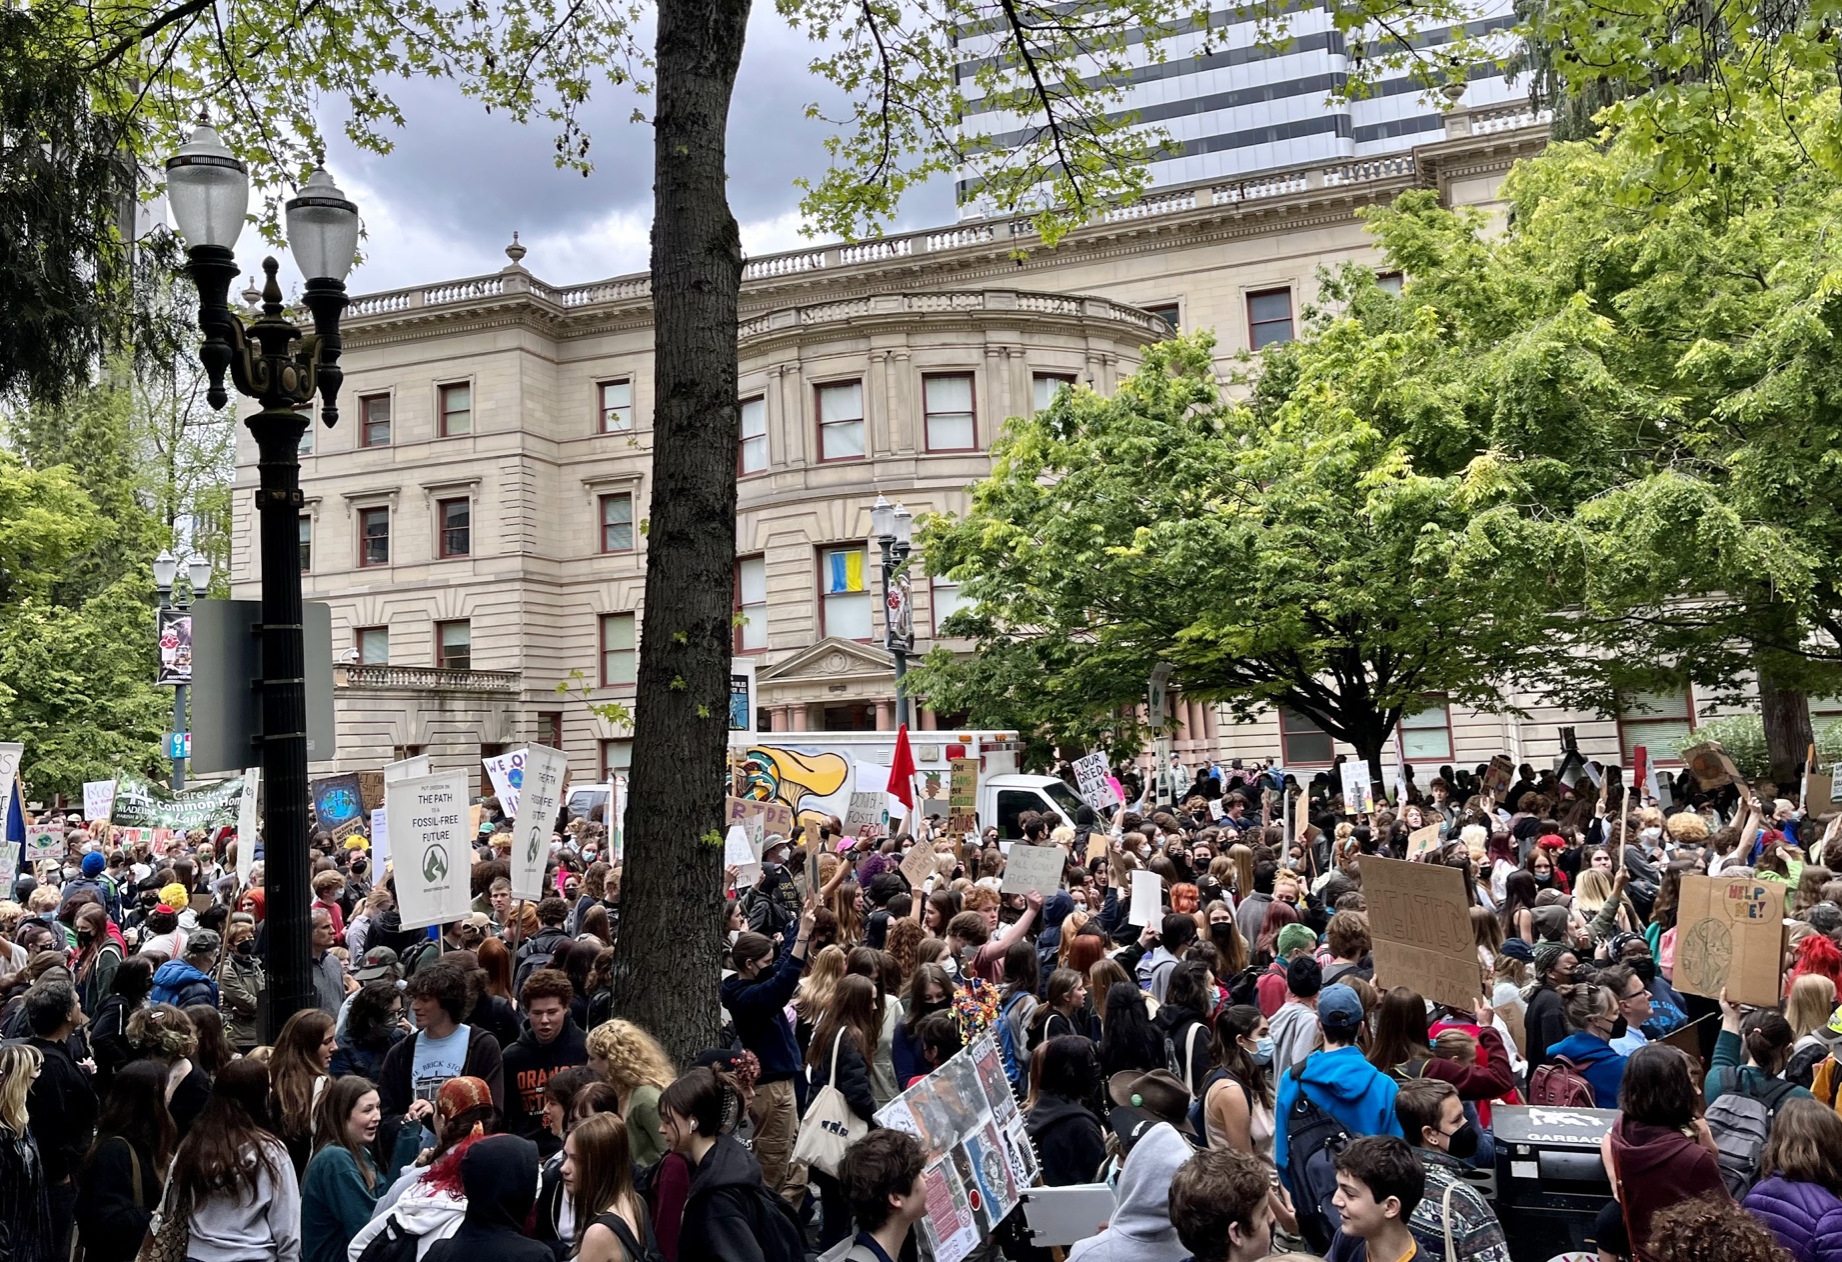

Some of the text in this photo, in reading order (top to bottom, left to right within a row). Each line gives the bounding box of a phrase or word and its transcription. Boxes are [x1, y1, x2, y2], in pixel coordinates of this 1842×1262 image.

[175, 745, 182, 754] 2
[486, 760, 506, 773] WE
[1078, 754, 1102, 770] YOUR
[1079, 765, 1104, 784] GREED
[362, 784, 379, 794] SHIT
[173, 791, 205, 800] Care
[418, 793, 453, 804] THE PATH
[157, 796, 242, 812] Common Hom
[412, 815, 459, 828] FOSSIL-FREE
[859, 823, 885, 837] FOOL
[423, 831, 450, 842] FUTURE
[1020, 848, 1033, 858] WE
[1012, 860, 1028, 869] ALL
[1729, 884, 1766, 900] HELP
[1735, 902, 1766, 918] ME!
[1366, 889, 1473, 952] HEATED
[422, 1060, 444, 1071] BRICK
[1527, 1133, 1603, 1144] GARBAG
